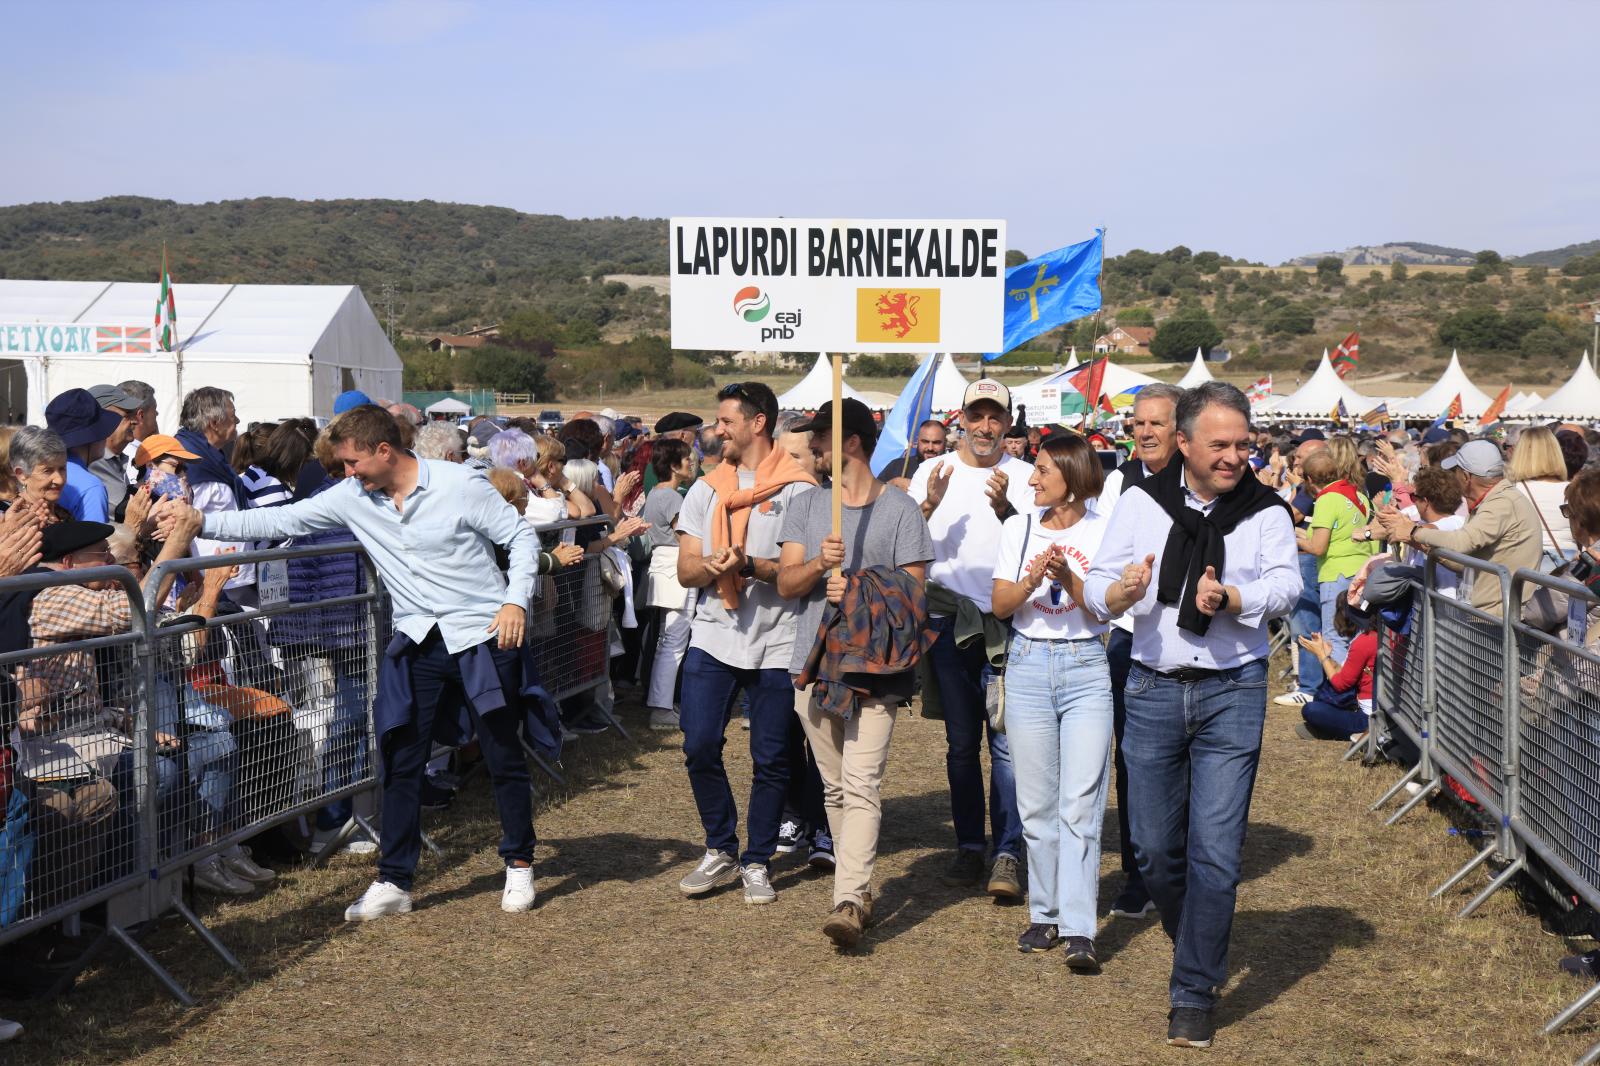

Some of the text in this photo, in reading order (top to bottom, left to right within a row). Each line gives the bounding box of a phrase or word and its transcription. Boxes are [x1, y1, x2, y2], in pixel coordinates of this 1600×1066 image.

[676, 226, 998, 277] LAPURDI BARNEKALDE
[774, 309, 801, 327] eaj
[761, 325, 794, 342] pnb
[1032, 600, 1054, 615] NATION
